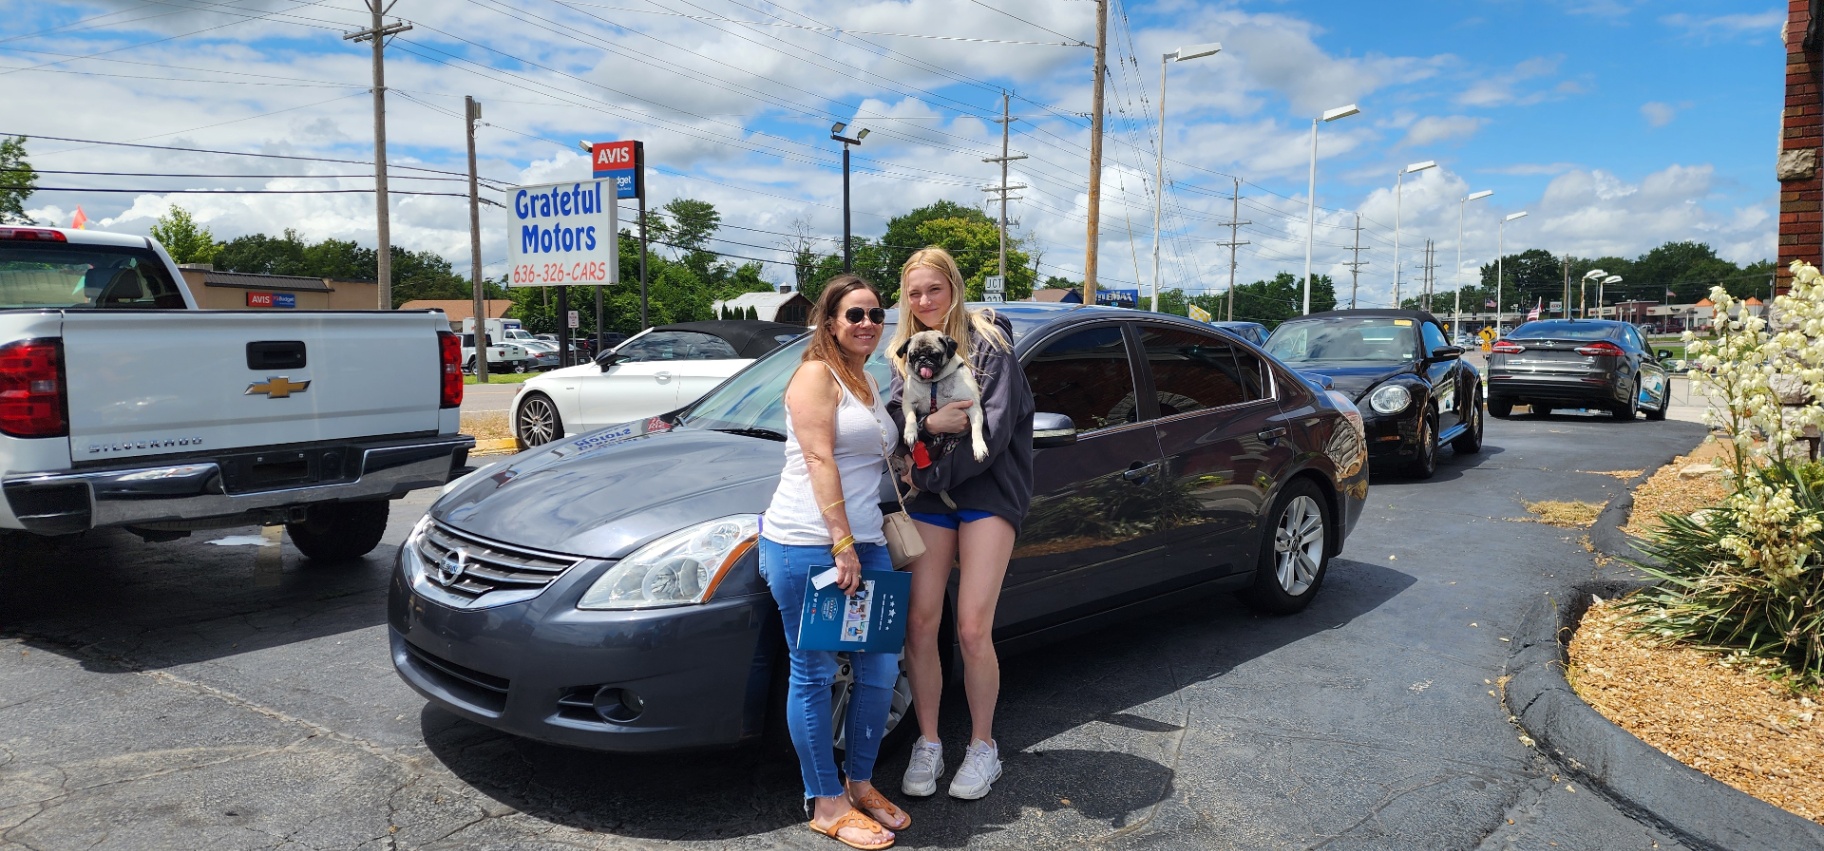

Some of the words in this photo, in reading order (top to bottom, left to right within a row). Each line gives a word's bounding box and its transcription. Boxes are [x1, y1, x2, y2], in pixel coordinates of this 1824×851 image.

[597, 147, 630, 164] AVIS
[617, 175, 631, 186] dget
[515, 181, 602, 219] Grateful
[522, 222, 596, 254] Motors
[513, 261, 606, 284] 636-326-CARS
[987, 278, 1002, 289] JCT
[251, 295, 270, 304] AVIS
[89, 437, 202, 452] SILVERADO
